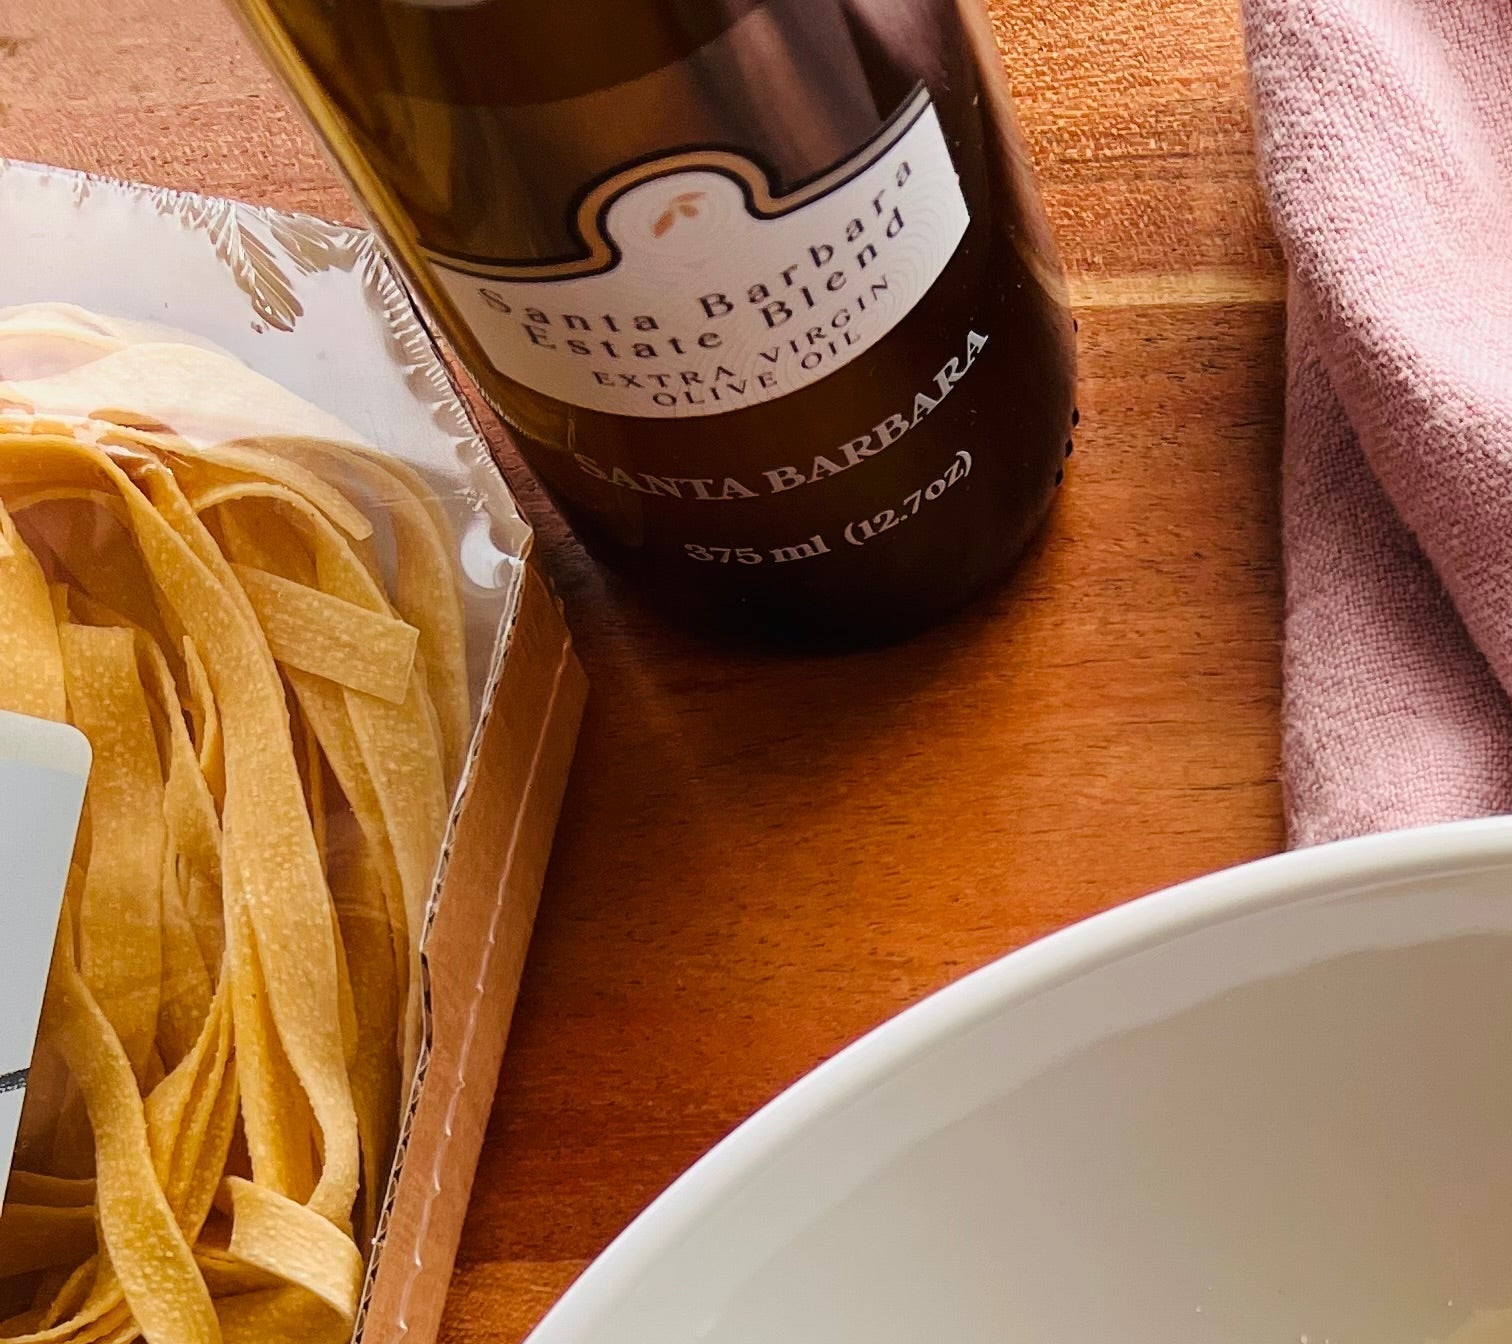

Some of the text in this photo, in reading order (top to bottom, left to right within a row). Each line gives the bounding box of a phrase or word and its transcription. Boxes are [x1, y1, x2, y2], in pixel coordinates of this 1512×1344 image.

[478, 161, 912, 332] Santa Barbara
[521, 206, 904, 358] Estate Blend
[592, 273, 889, 389] EXTRA VIRGIN
[652, 331, 860, 407] OLIVE OIL
[573, 329, 989, 501] SANTA BARBARA
[683, 450, 973, 565] 375 ml (12.7oz)
